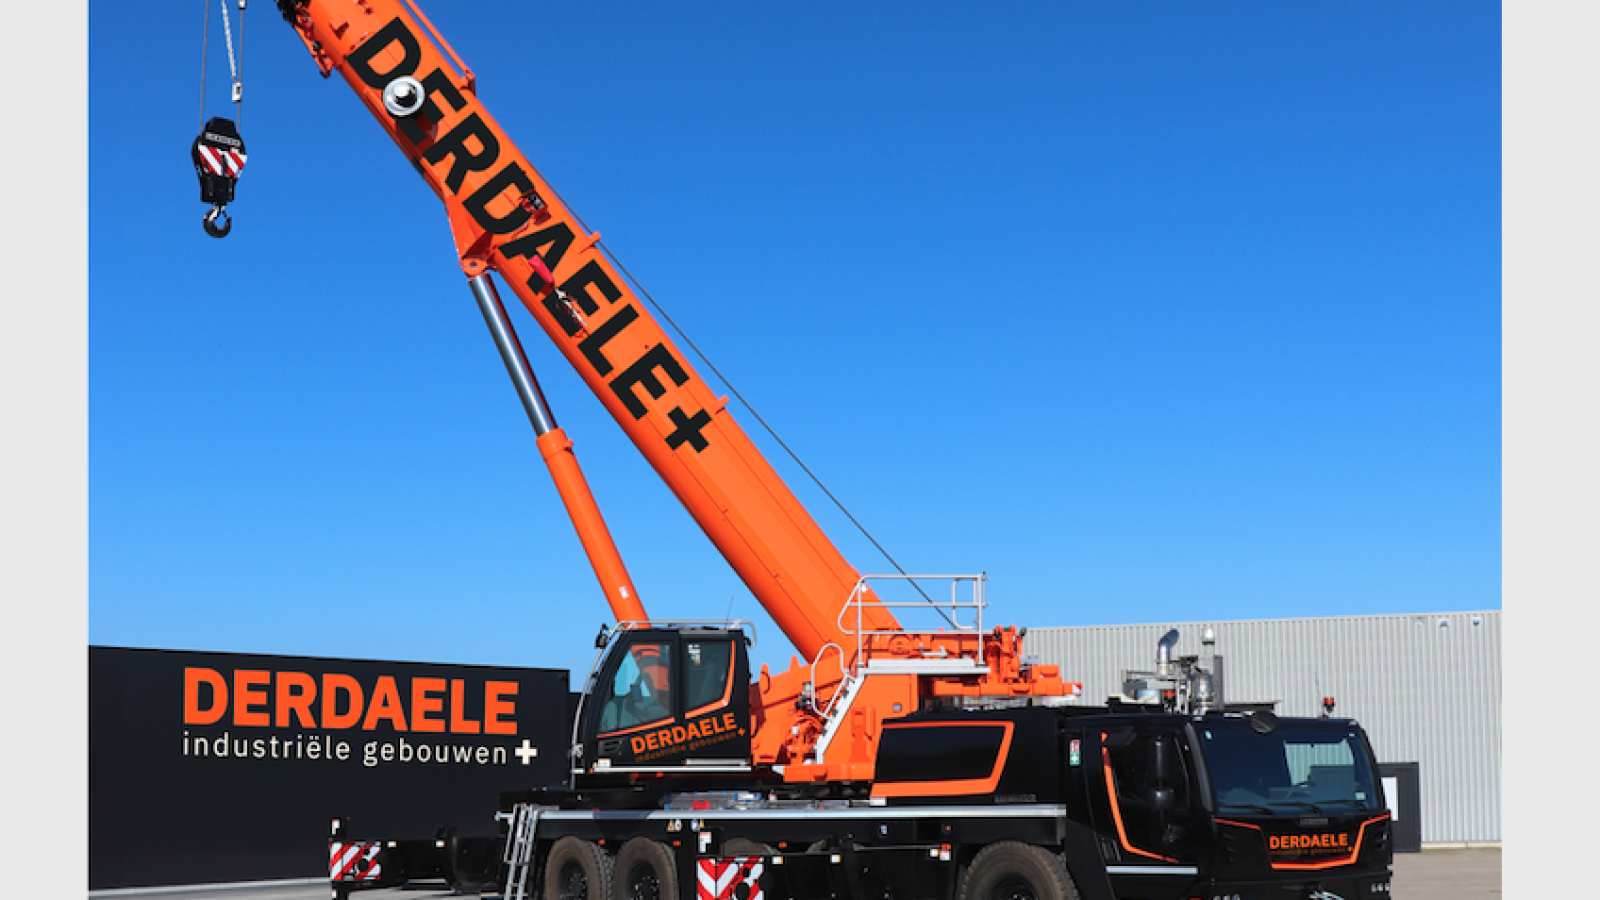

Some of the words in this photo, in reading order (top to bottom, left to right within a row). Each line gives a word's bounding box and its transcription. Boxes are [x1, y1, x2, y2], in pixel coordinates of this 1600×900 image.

[184, 667, 518, 735] DERDAELE
[183, 731, 350, 761] industriële
[630, 712, 737, 754] DERDAELE
[1269, 833, 1348, 850] DERDAELE
